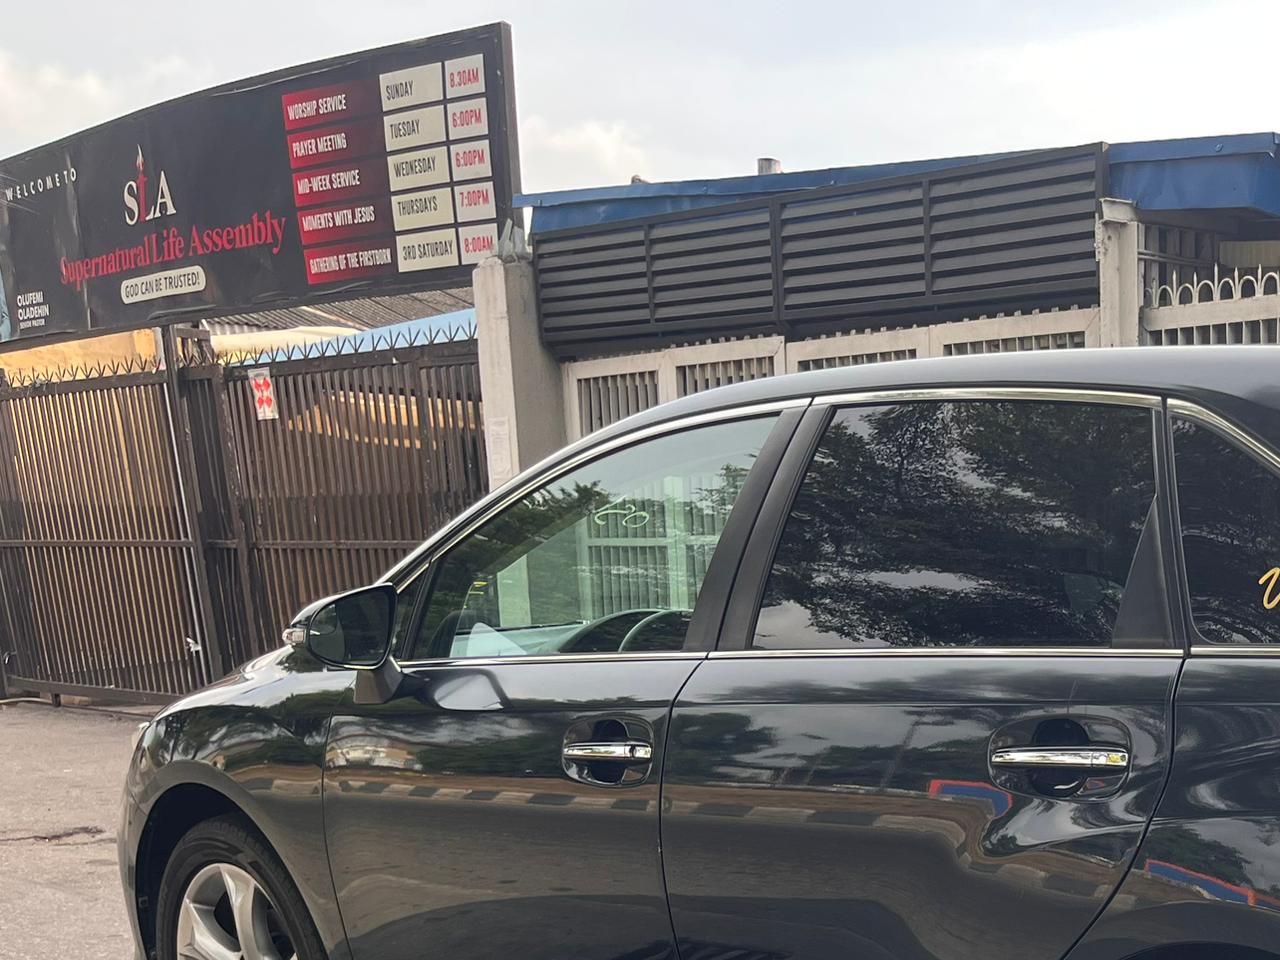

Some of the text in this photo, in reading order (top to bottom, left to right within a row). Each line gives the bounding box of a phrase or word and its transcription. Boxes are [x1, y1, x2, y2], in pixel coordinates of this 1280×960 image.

[449, 67, 479, 88] 8.30AM
[385, 80, 414, 101] SUNDAY
[287, 94, 346, 120] WORSHIP SERVICE
[452, 108, 482, 128] 6:00PM
[390, 119, 420, 139] TUESDAY
[292, 133, 347, 158] PRAYER MEETING
[393, 156, 436, 178] WEDNESDAY
[455, 148, 485, 167] 6:00PM
[5, 167, 77, 201] WELCOME TO
[297, 169, 360, 195] MID-WEEK SERVICE
[123, 170, 177, 225] SLA
[397, 195, 438, 216] THURSDAYS
[459, 189, 490, 207] 7:00PM
[302, 205, 375, 232] MOMENTS WITH JESUS
[60, 209, 286, 291] Supernatural Life Assembly
[402, 239, 453, 260] 3RD SATURDAY
[463, 235, 493, 254] 8:00AM
[309, 247, 392, 274] GATHERING OF THE FIRSTBORN
[124, 271, 200, 298] GOD CAN BE TRUSTED!
[17, 291, 43, 307] OLUFEMI
[18, 303, 49, 320] OLADEHIN
